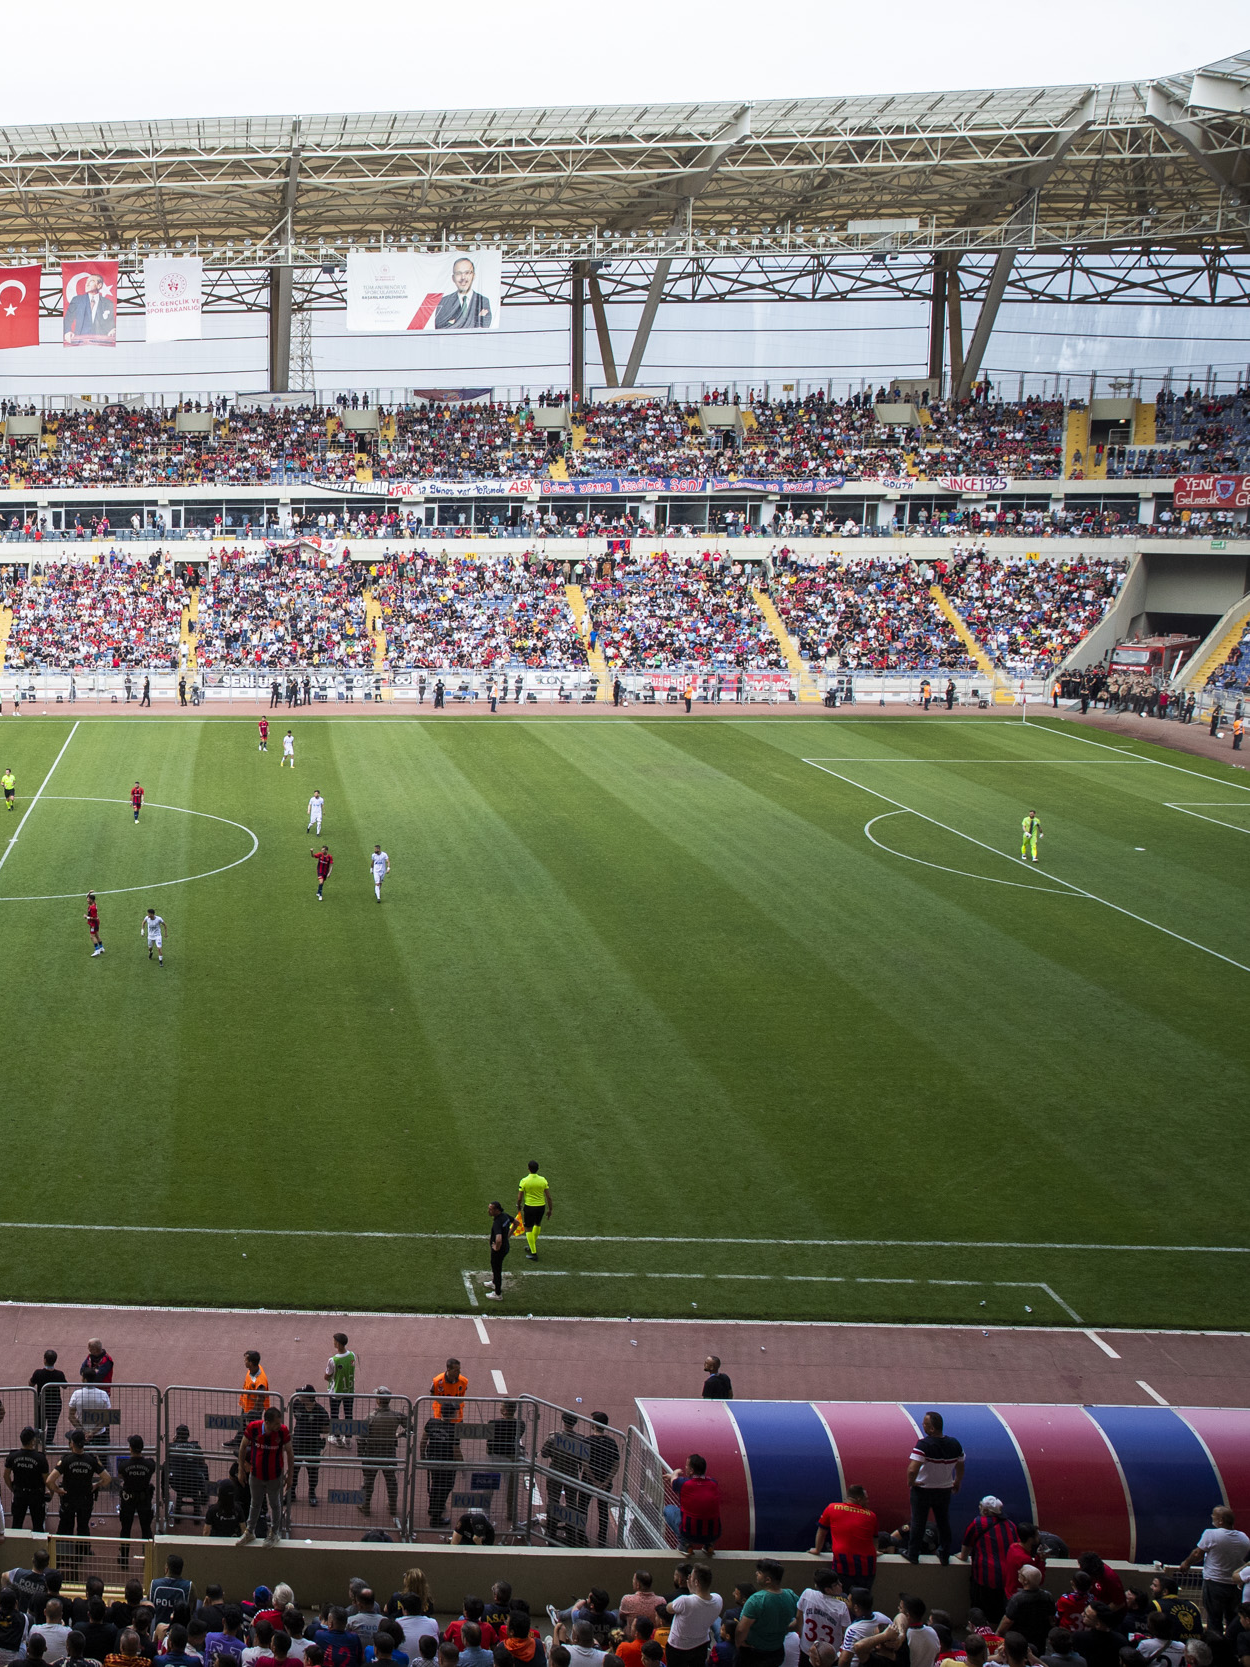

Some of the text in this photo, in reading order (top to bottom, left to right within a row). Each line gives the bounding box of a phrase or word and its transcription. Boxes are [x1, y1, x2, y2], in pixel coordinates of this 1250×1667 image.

[353, 480, 389, 495] KADAR
[208, 1415, 241, 1428] POLİS
[332, 1420, 368, 1434] POLİS
[805, 1618, 834, 1644] 33
